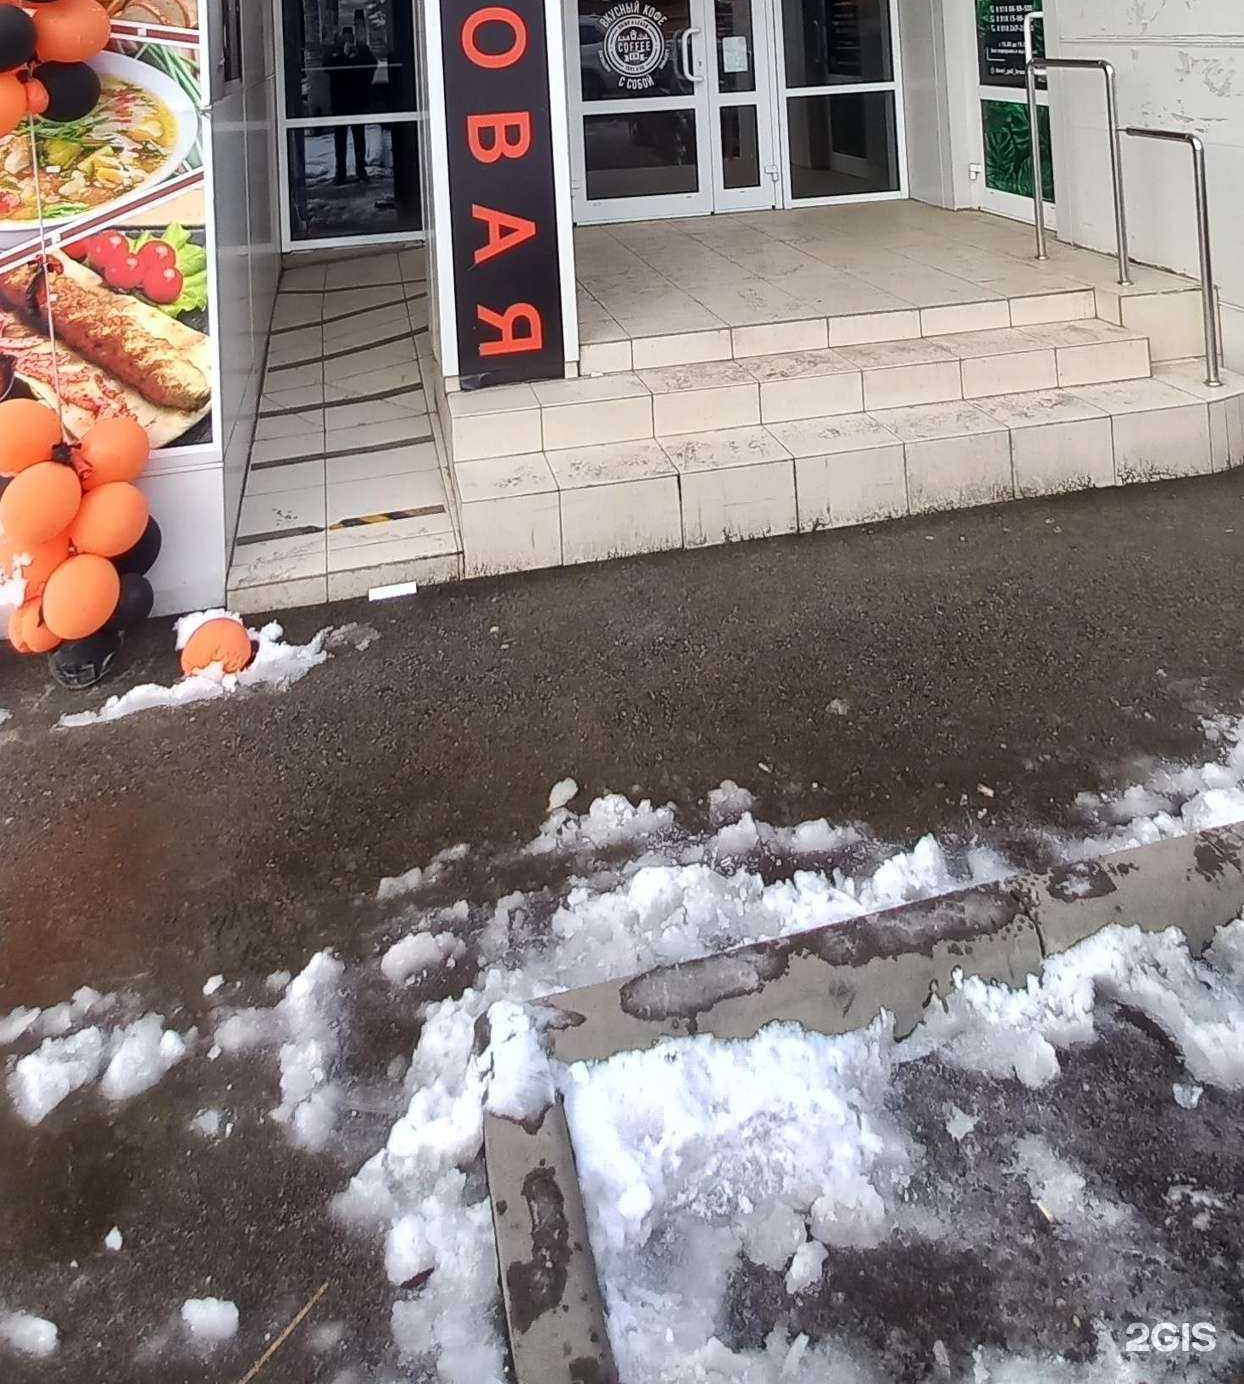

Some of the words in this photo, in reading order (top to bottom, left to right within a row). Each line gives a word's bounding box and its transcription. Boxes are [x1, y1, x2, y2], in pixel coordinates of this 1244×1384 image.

[600, 0, 640, 28] ВКУСНЫЙ
[643, 4, 668, 26] КОФЕ
[617, 40, 651, 54] COFFEE
[618, 76, 626, 87] С
[627, 74, 655, 90] СОБОЙ
